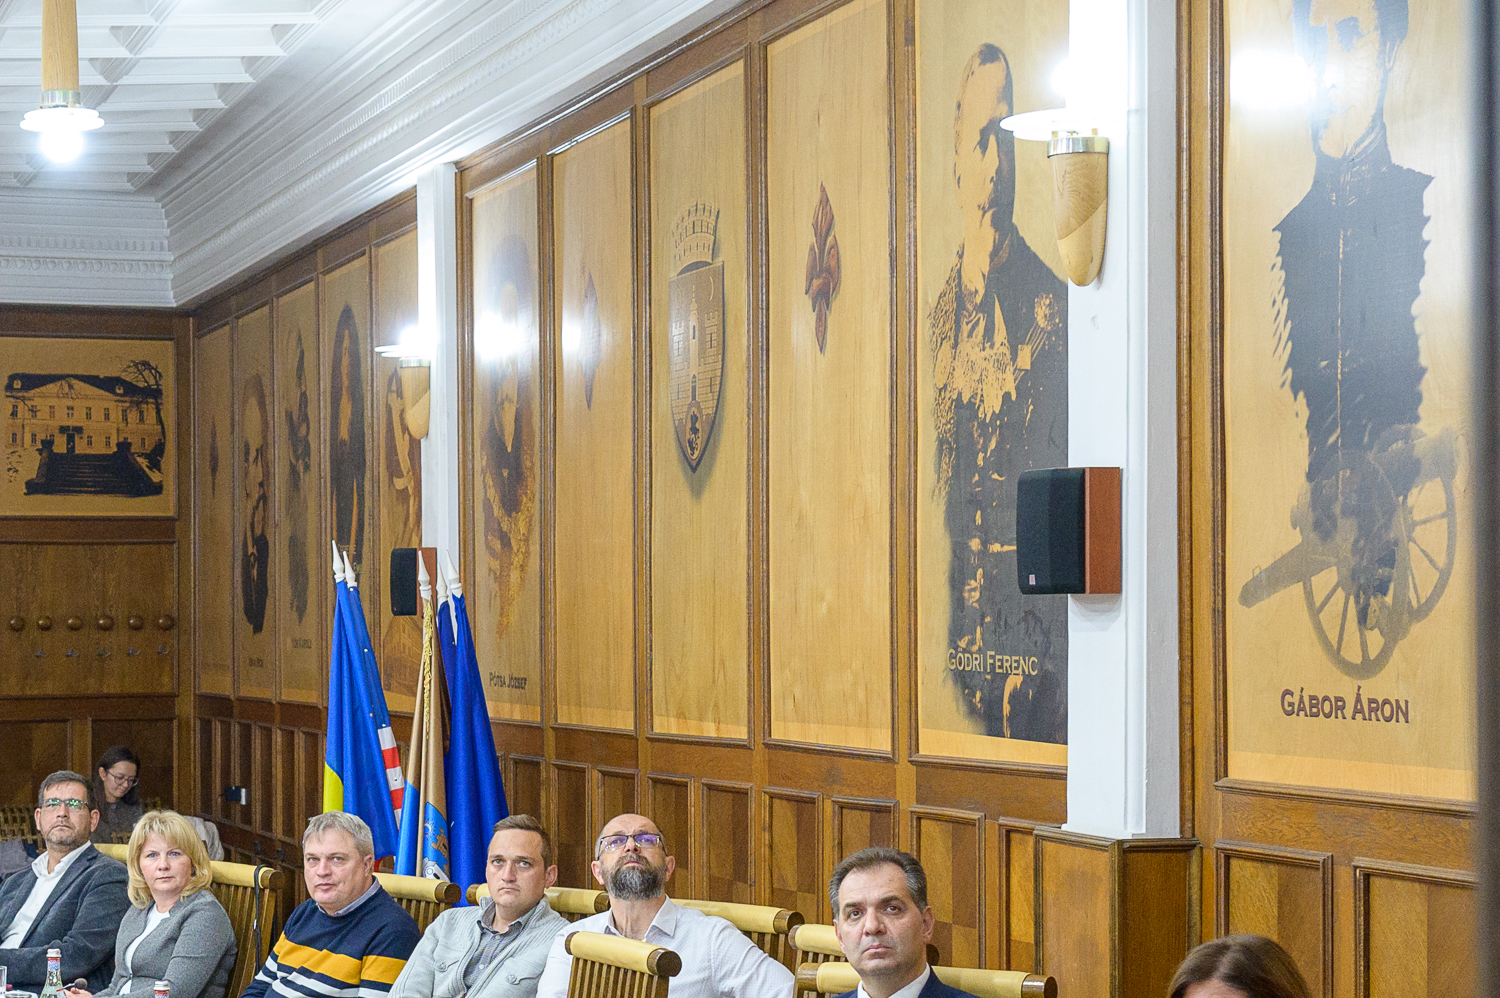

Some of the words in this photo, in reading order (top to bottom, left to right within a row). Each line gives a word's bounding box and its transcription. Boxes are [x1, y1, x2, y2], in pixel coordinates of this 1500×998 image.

[947, 648, 984, 672] GÖDRI
[986, 650, 1038, 676] FERENC
[1280, 686, 1347, 720] GÁBOR
[1351, 684, 1410, 724] ÁRON
